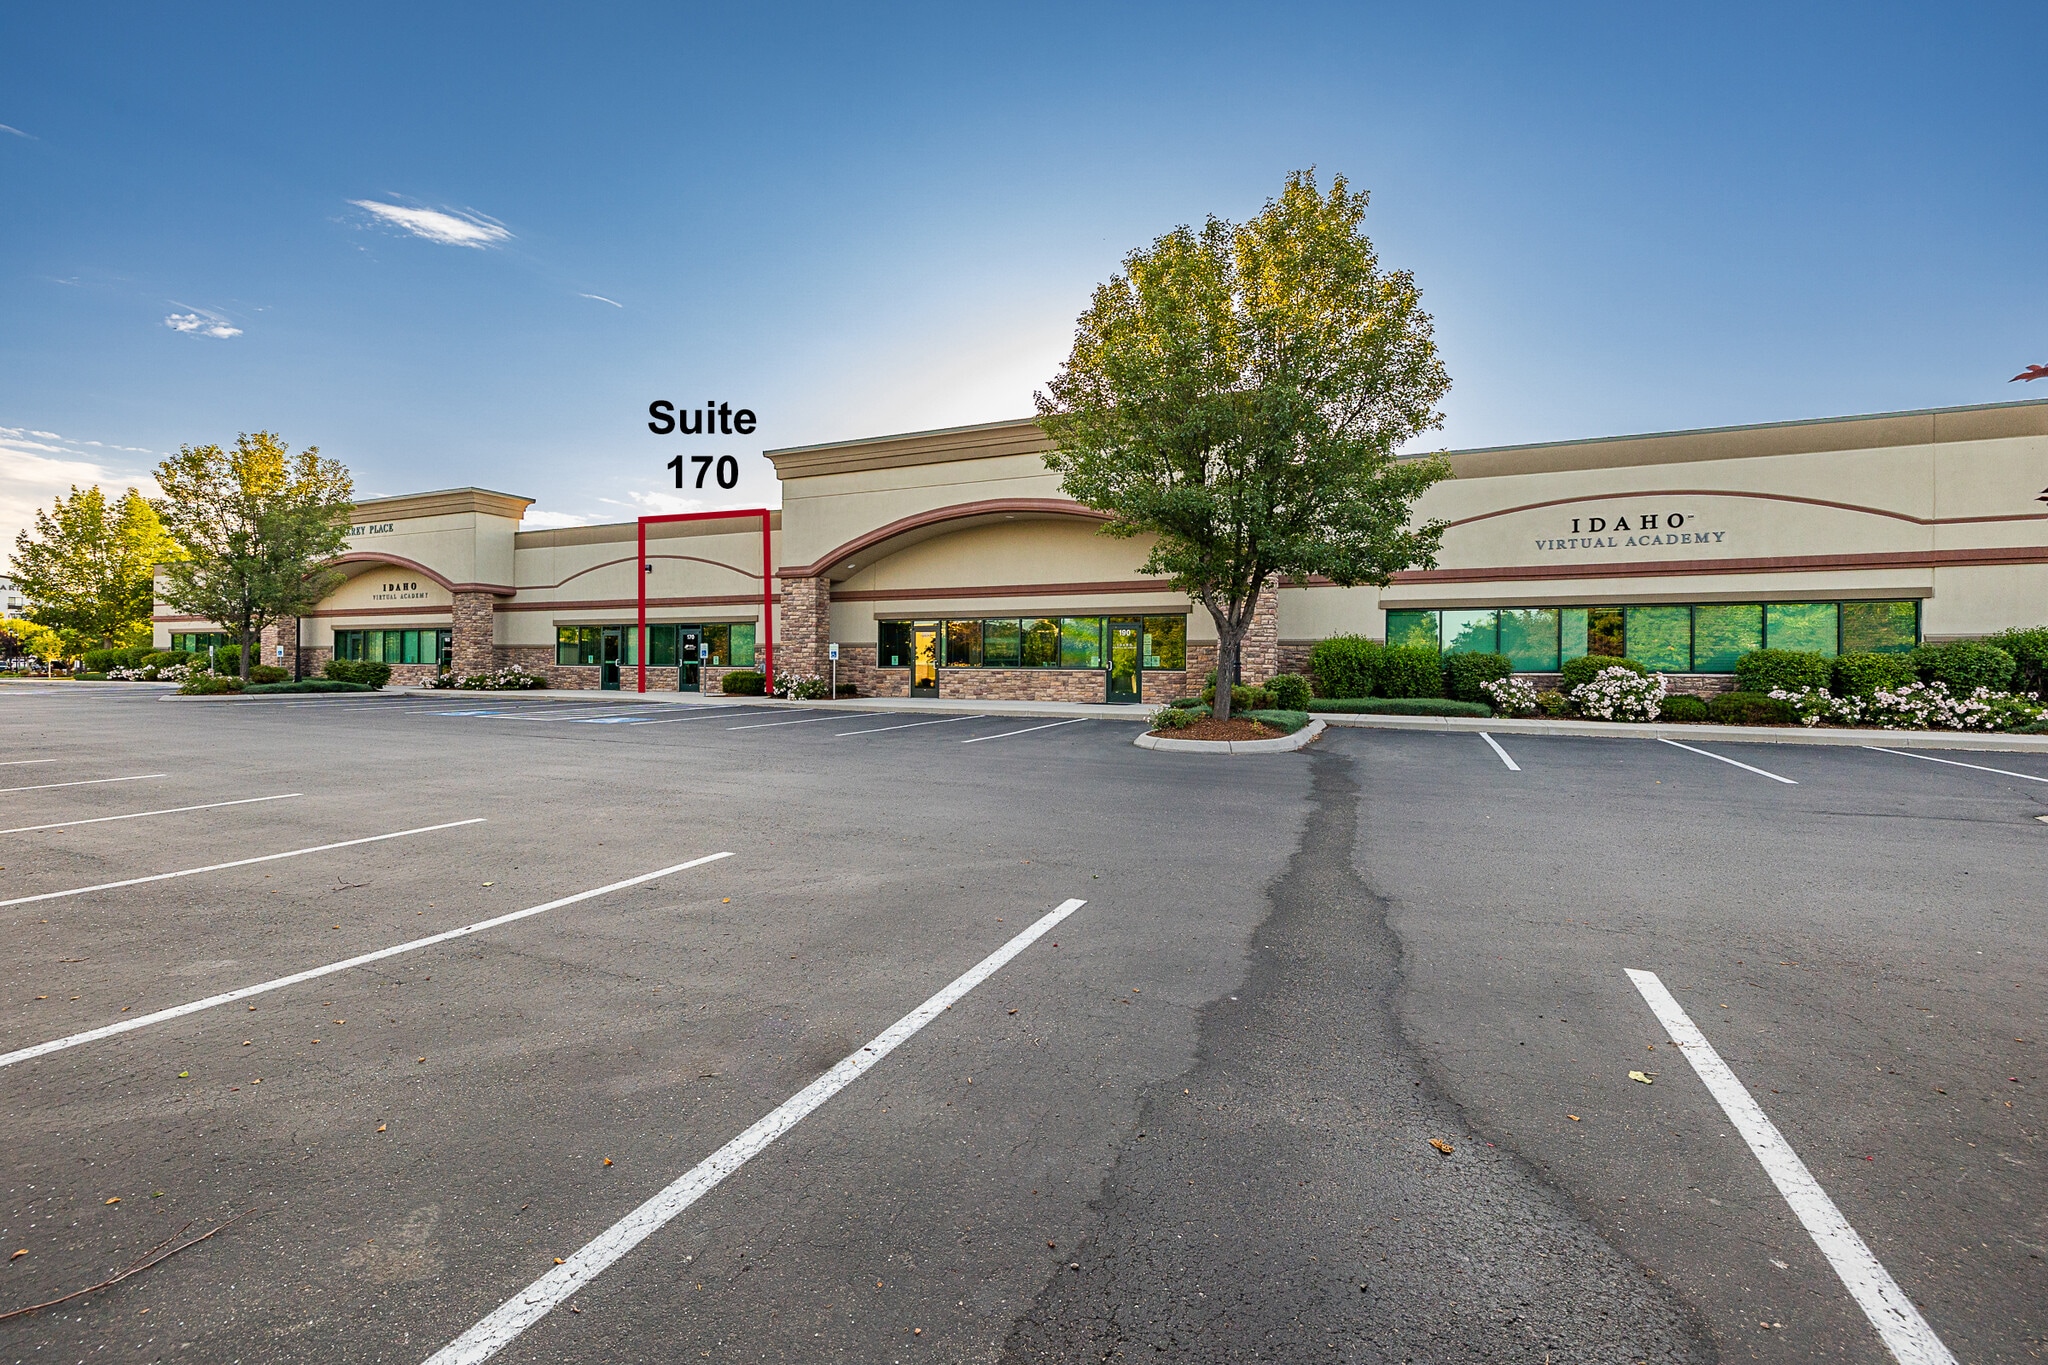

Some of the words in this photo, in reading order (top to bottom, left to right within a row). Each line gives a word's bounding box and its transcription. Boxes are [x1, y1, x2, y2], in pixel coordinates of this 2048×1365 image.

[369, 523, 394, 534] PLACE
[1572, 513, 1684, 533] IDAHO
[1535, 537, 1617, 550] VIRTUAL
[1625, 531, 1726, 547] ACADEMY
[382, 582, 417, 591] IDAHO
[400, 592, 429, 600] ACADEMY
